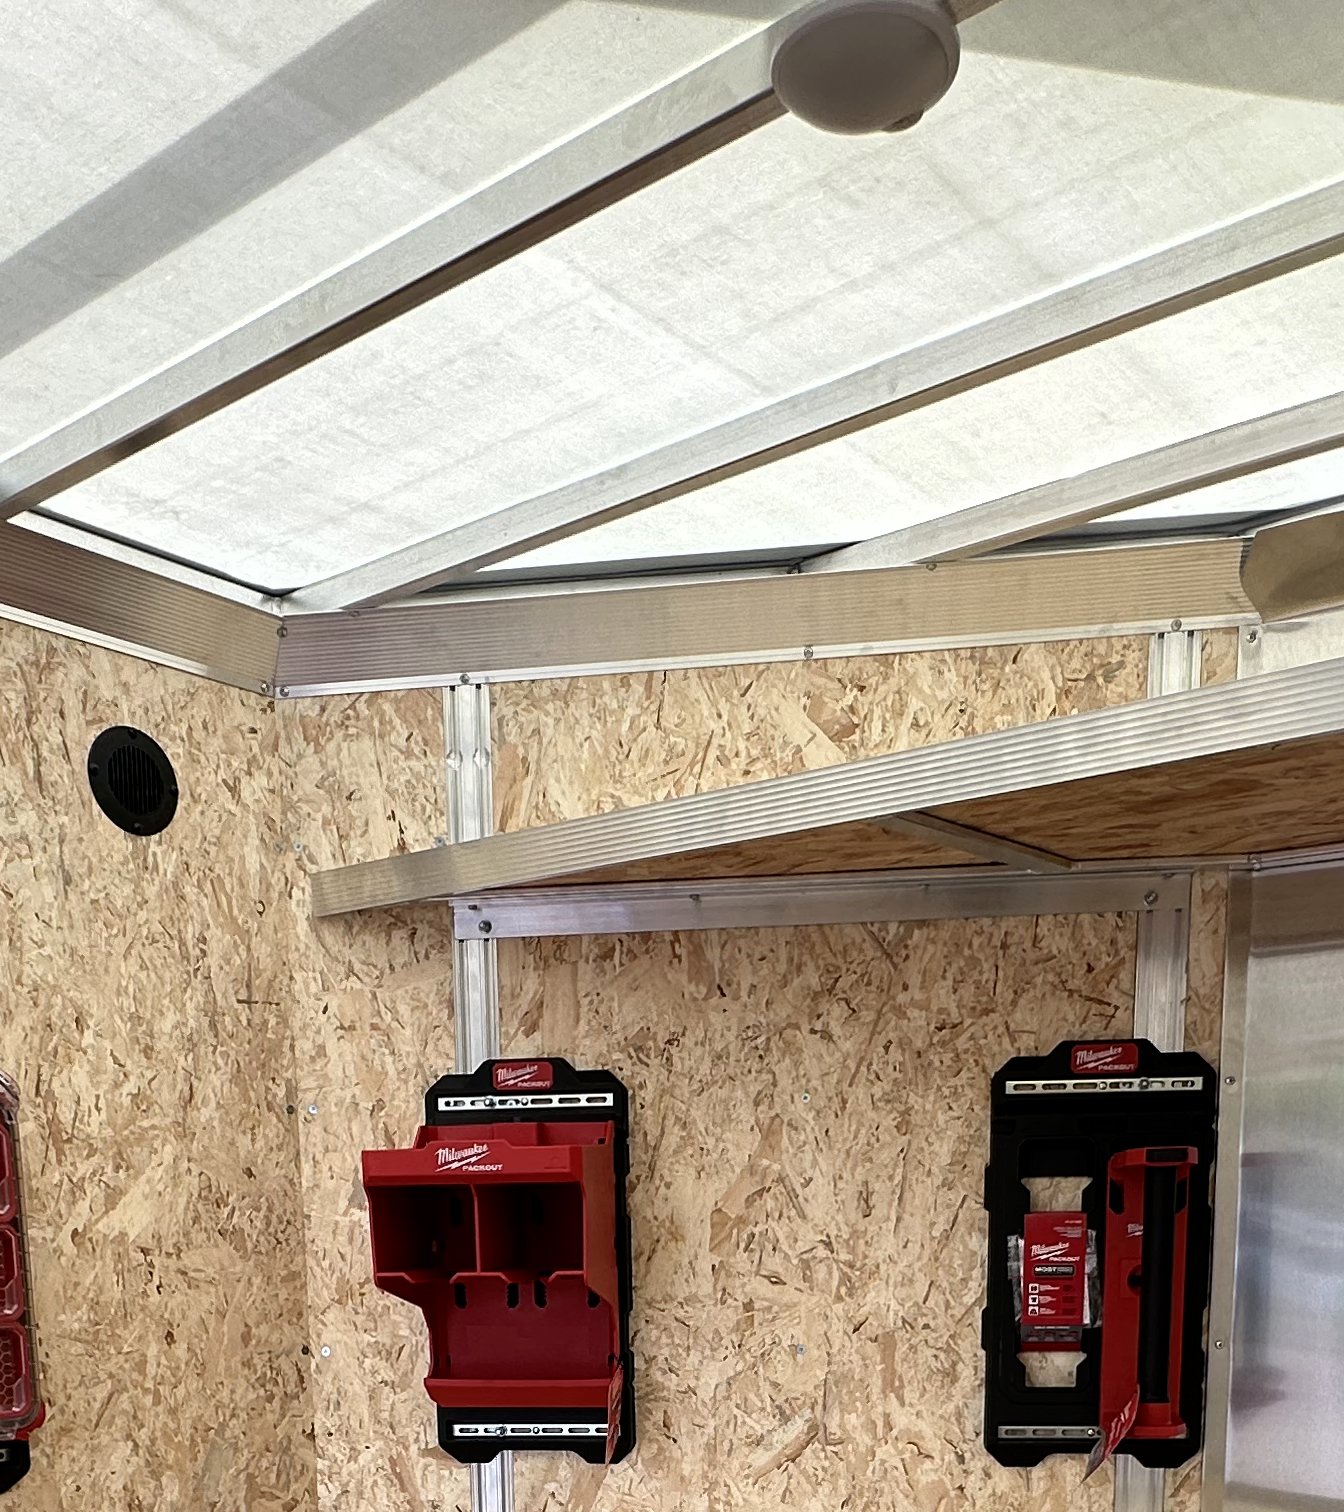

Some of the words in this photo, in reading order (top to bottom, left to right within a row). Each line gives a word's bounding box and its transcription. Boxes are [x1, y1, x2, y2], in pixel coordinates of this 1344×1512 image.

[1075, 1046, 1123, 1065] Milwaukee
[496, 1064, 538, 1082] Milwaukee
[434, 1143, 489, 1165] Milwaukee
